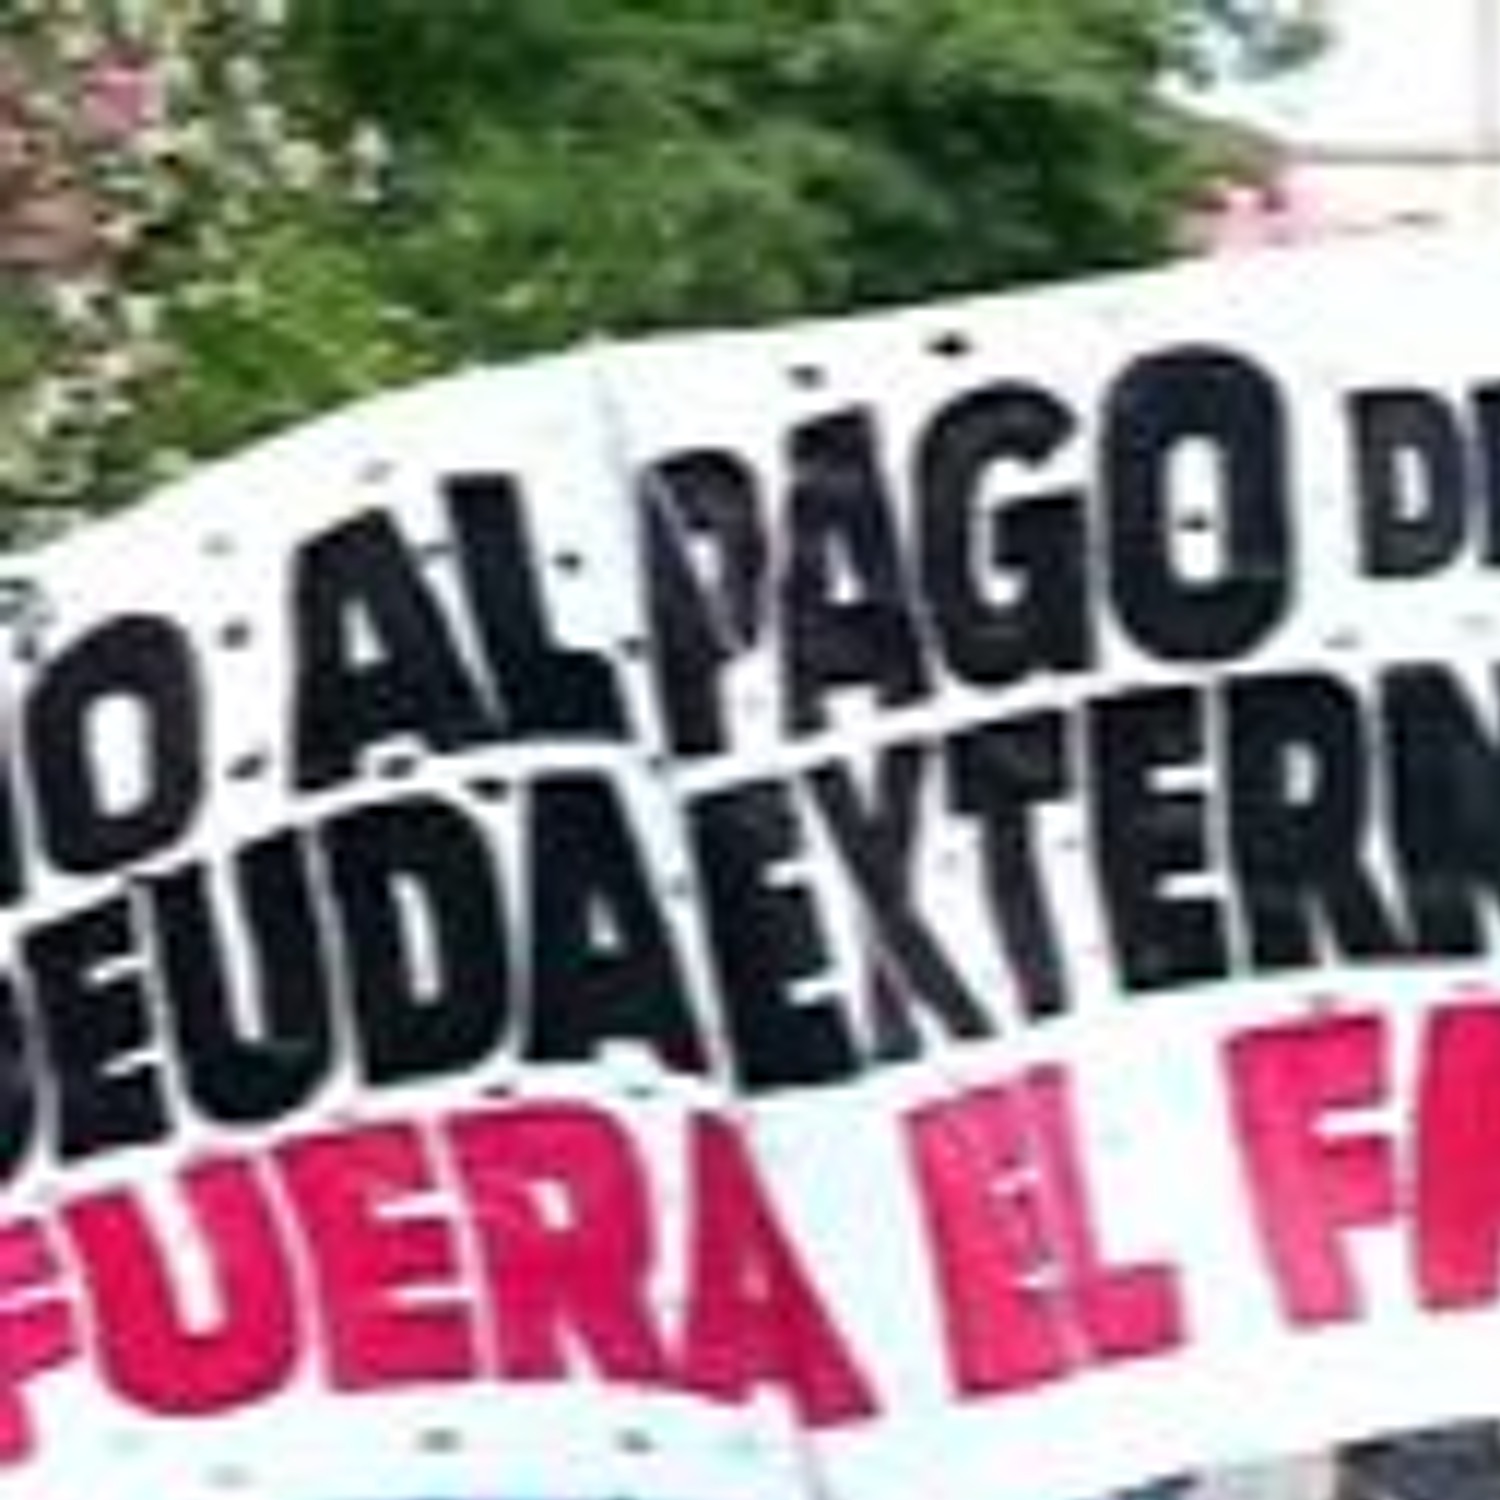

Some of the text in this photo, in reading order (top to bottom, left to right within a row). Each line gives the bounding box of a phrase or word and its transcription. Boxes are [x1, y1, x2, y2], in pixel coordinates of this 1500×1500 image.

[0, 612, 203, 906] O
[288, 472, 636, 792] AL
[638, 343, 1300, 758] PAGO
[900, 1062, 1188, 1397] EL
